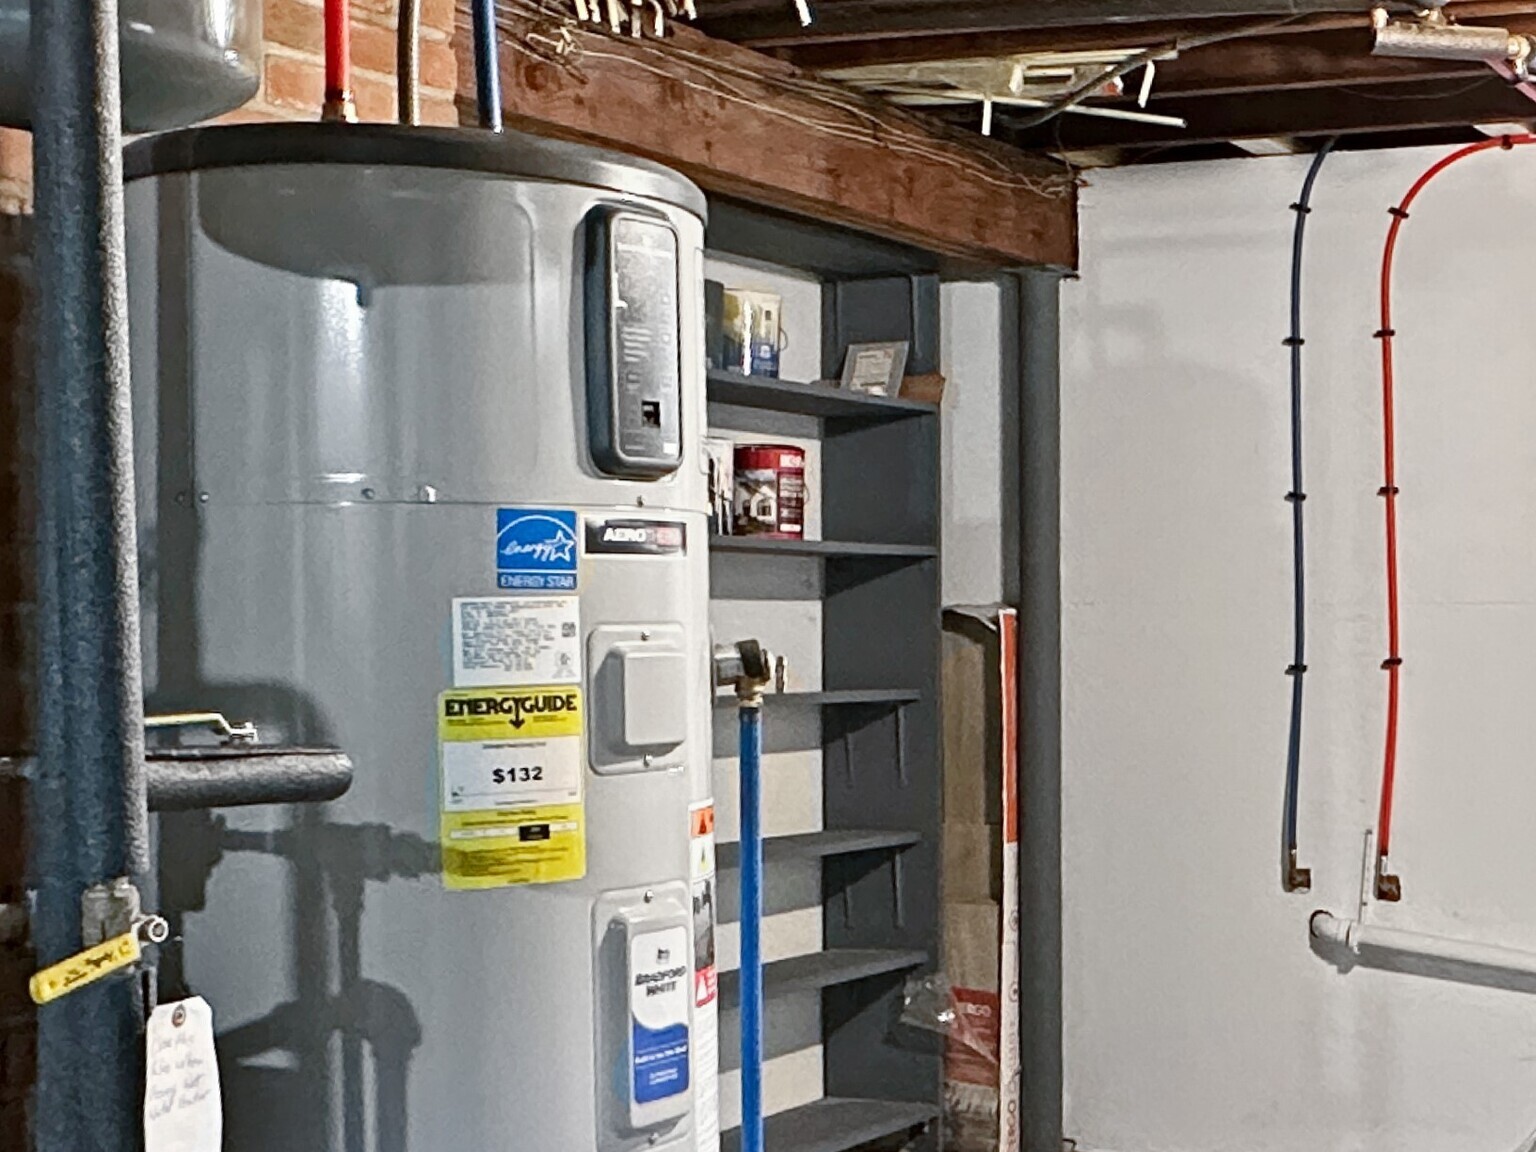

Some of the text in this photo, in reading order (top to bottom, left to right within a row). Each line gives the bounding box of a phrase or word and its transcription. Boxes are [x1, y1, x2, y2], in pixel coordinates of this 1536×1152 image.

[501, 574, 575, 588] ENERGY STAR
[492, 766, 543, 784] $132
